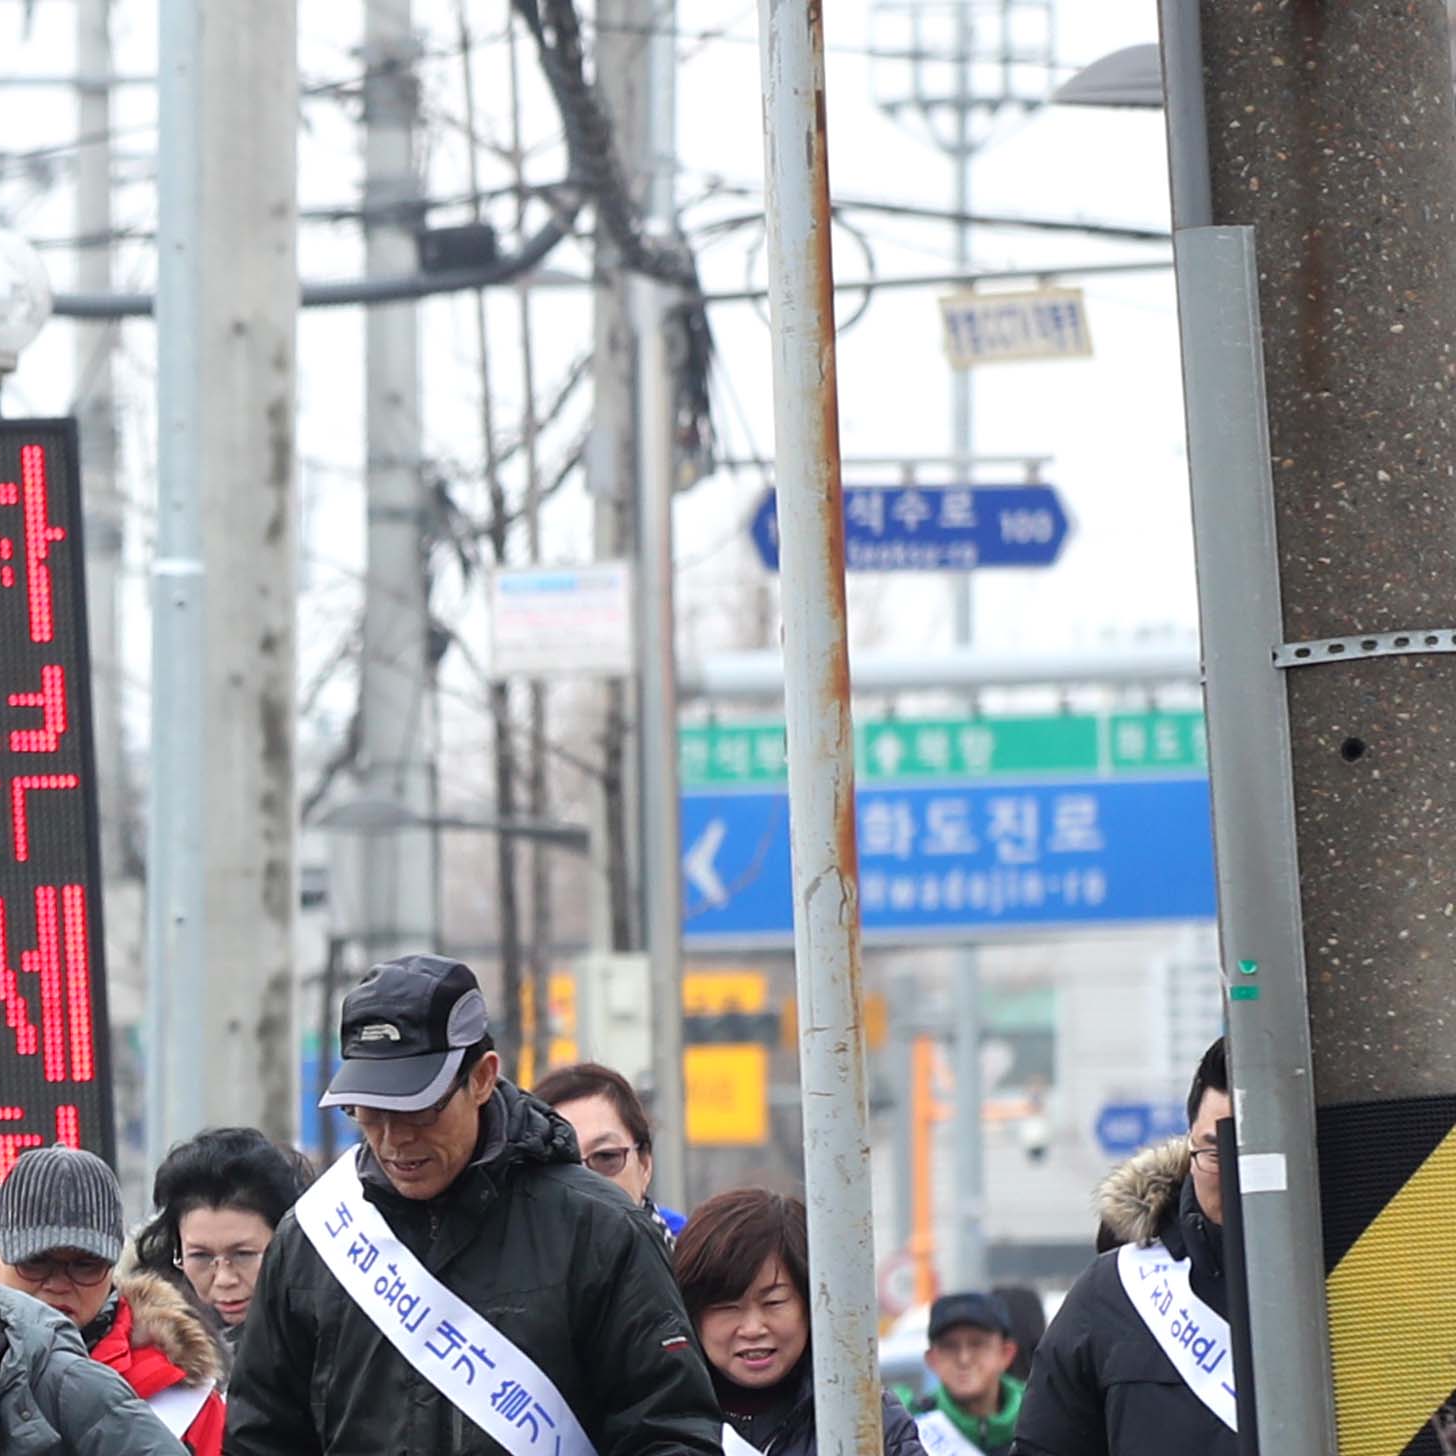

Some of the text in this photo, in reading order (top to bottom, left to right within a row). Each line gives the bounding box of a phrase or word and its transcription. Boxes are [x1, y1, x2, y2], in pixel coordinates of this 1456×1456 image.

[861, 793, 1104, 864] 화도진로
[324, 1201, 353, 1239] 내
[424, 1319, 497, 1386] 내가
